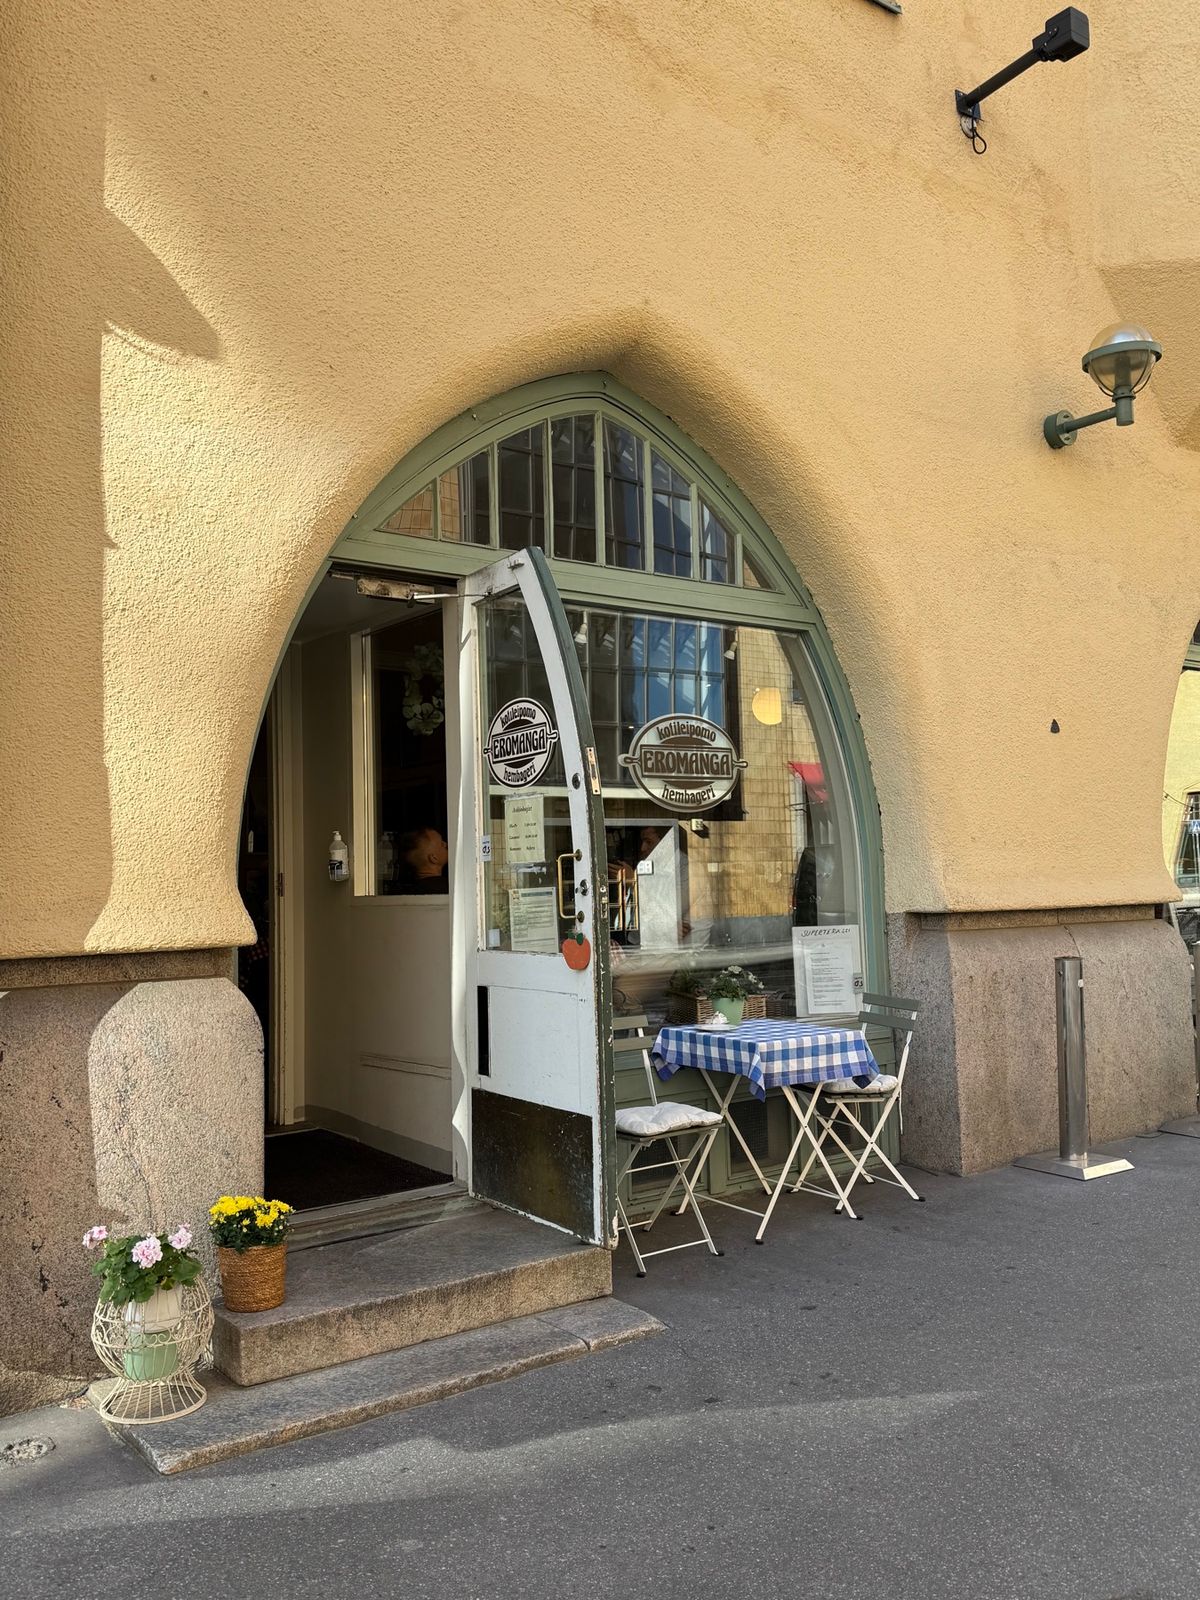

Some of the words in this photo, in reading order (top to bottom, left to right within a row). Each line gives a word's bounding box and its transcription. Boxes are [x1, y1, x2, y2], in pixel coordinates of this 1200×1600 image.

[656, 721, 717, 742] kotileipomo
[493, 729, 546, 759] EROMANGA
[503, 762, 536, 782] hembageri
[643, 750, 731, 776] EROMANGA
[661, 784, 716, 806] hembageri
